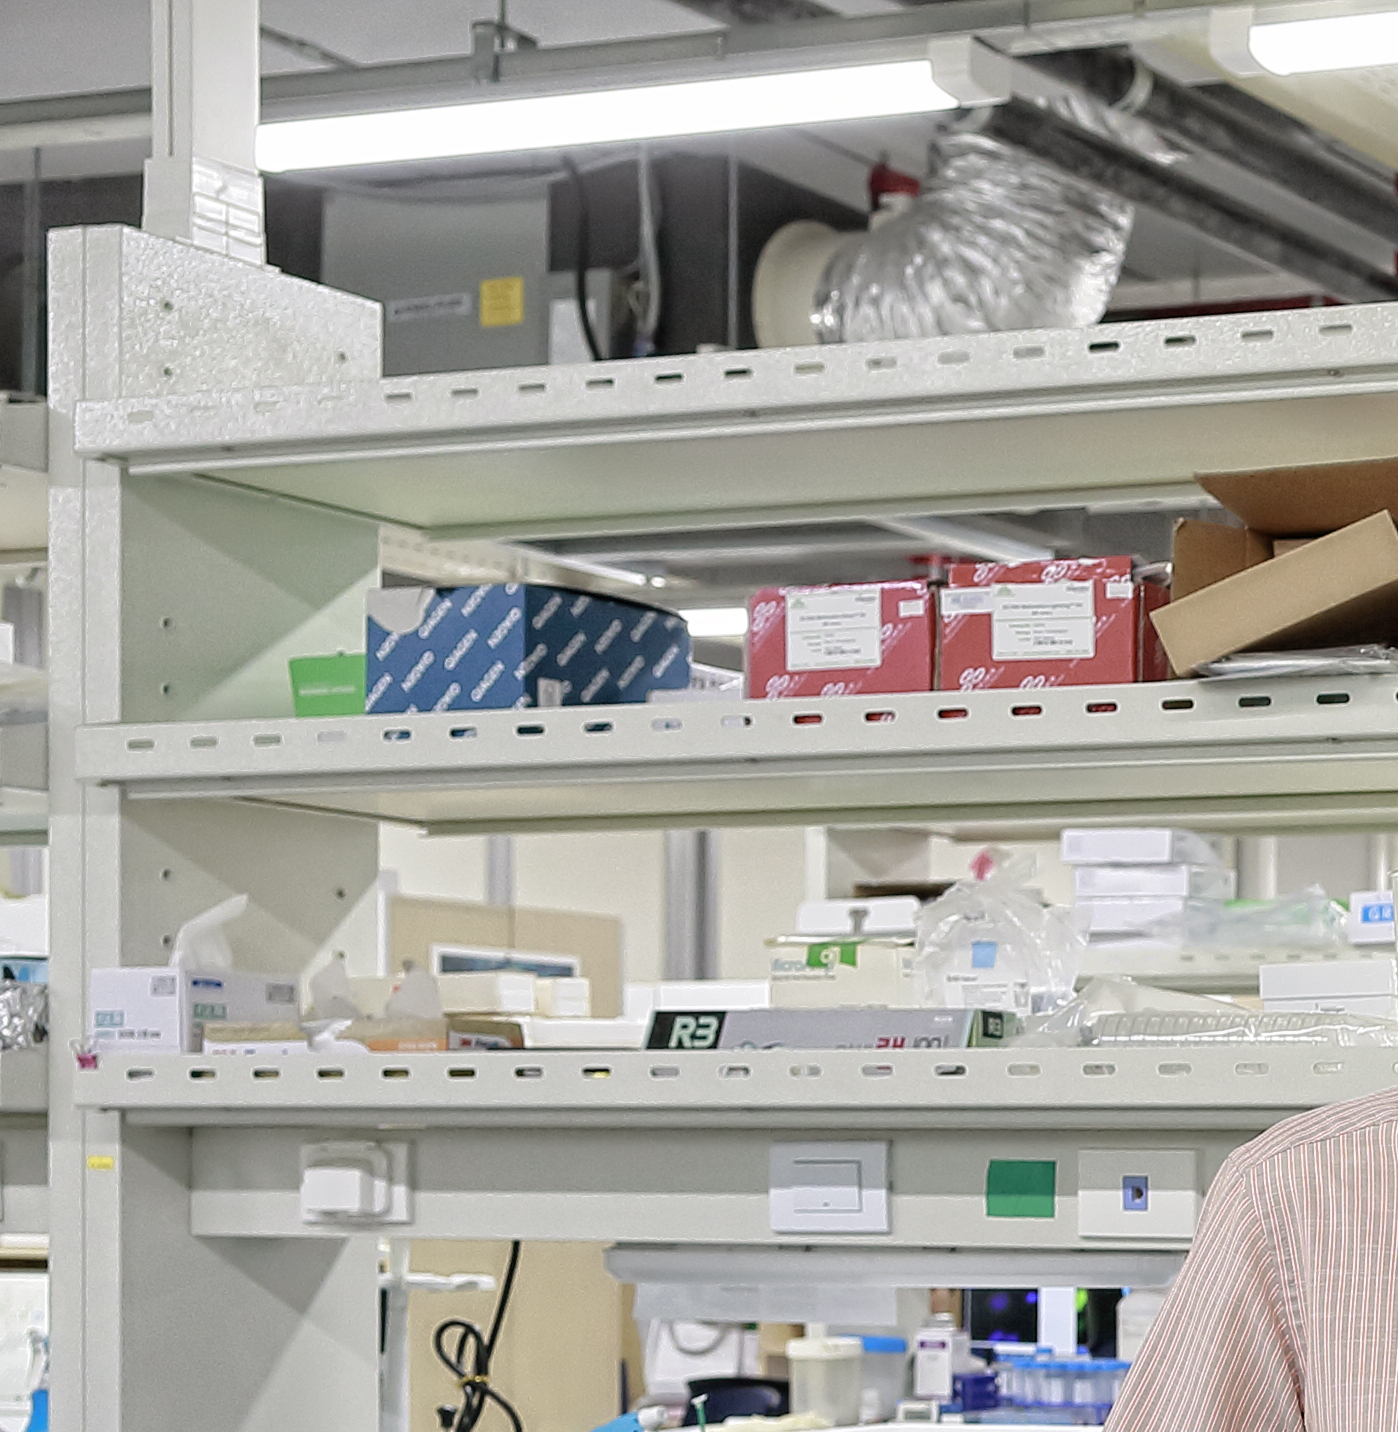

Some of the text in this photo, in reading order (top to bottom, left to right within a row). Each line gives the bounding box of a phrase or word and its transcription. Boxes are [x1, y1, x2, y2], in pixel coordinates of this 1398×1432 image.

[418, 598, 453, 640] QIAGEN
[487, 607, 522, 649] QIAGEN
[444, 628, 479, 671] QIAGEN
[401, 650, 436, 693] QIAGEN
[471, 660, 505, 702] QIAGEN
[668, 1014, 719, 1049] R3
